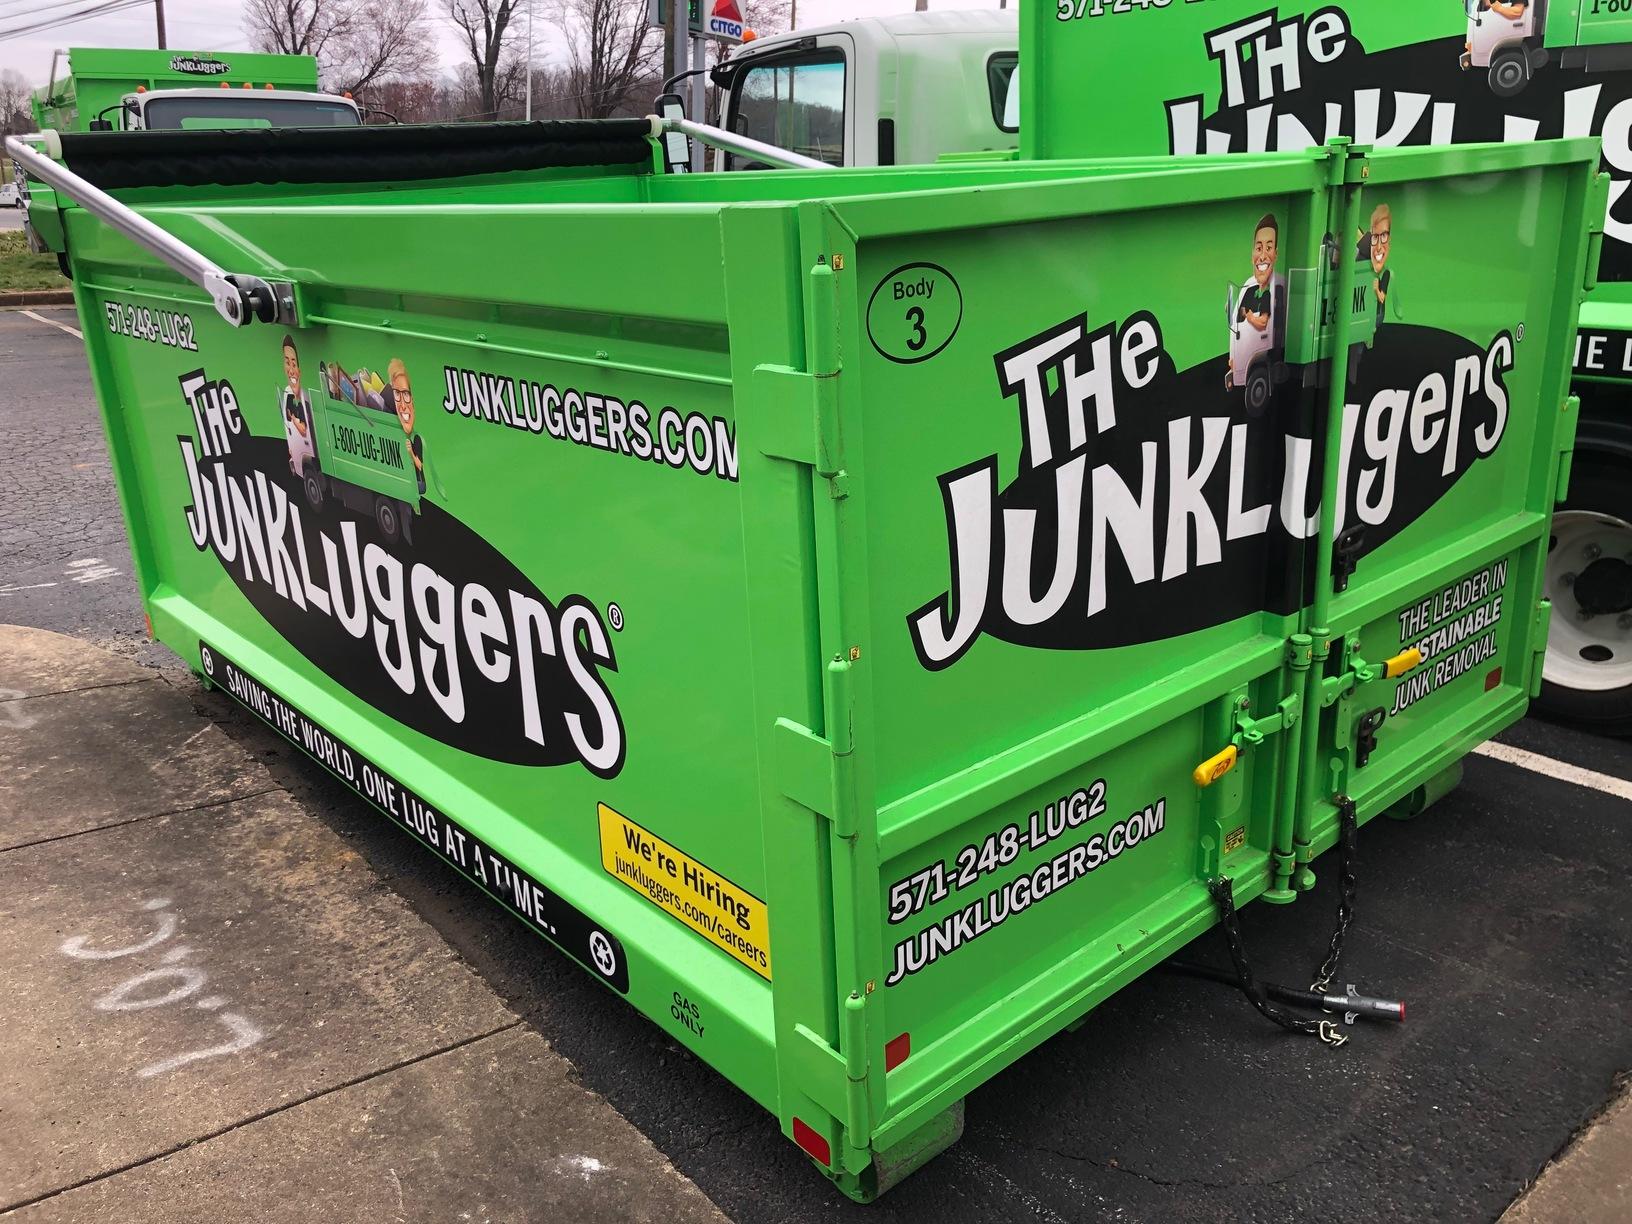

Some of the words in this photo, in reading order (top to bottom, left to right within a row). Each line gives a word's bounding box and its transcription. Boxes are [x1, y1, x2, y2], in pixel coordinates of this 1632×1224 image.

[710, 19, 743, 37] CITGO
[105, 301, 198, 351] 571-248-LUG2
[893, 277, 935, 300] Body
[905, 306, 927, 351] 3
[332, 424, 404, 470] 1-800-LUG-JUNK
[444, 367, 739, 481] JUNKLUGGERS.COM
[1398, 596, 1502, 676] STAINABLE
[1400, 599, 1431, 641] THE
[1433, 569, 1490, 623] LEADER
[1491, 560, 1508, 592] IN
[1390, 667, 1432, 716] JUNK
[1434, 629, 1498, 693] REMOVAL
[226, 665, 271, 719] SAVING
[272, 698, 300, 741] THE
[300, 718, 361, 791] WORLD,
[362, 764, 399, 817] ONE
[402, 791, 439, 847] LUG
[446, 823, 466, 867] AT
[474, 844, 488, 885] A
[489, 854, 557, 935] TIME.
[622, 823, 677, 878] We're
[683, 860, 752, 931] Hiring
[889, 780, 1107, 923] 571-248-LUG2
[614, 851, 768, 968] junkluggers.com/careers
[887, 799, 1166, 986] JUNKLUGGERS.COM
[671, 1004, 705, 1038] ONLY
[673, 991, 700, 1019] GAS
